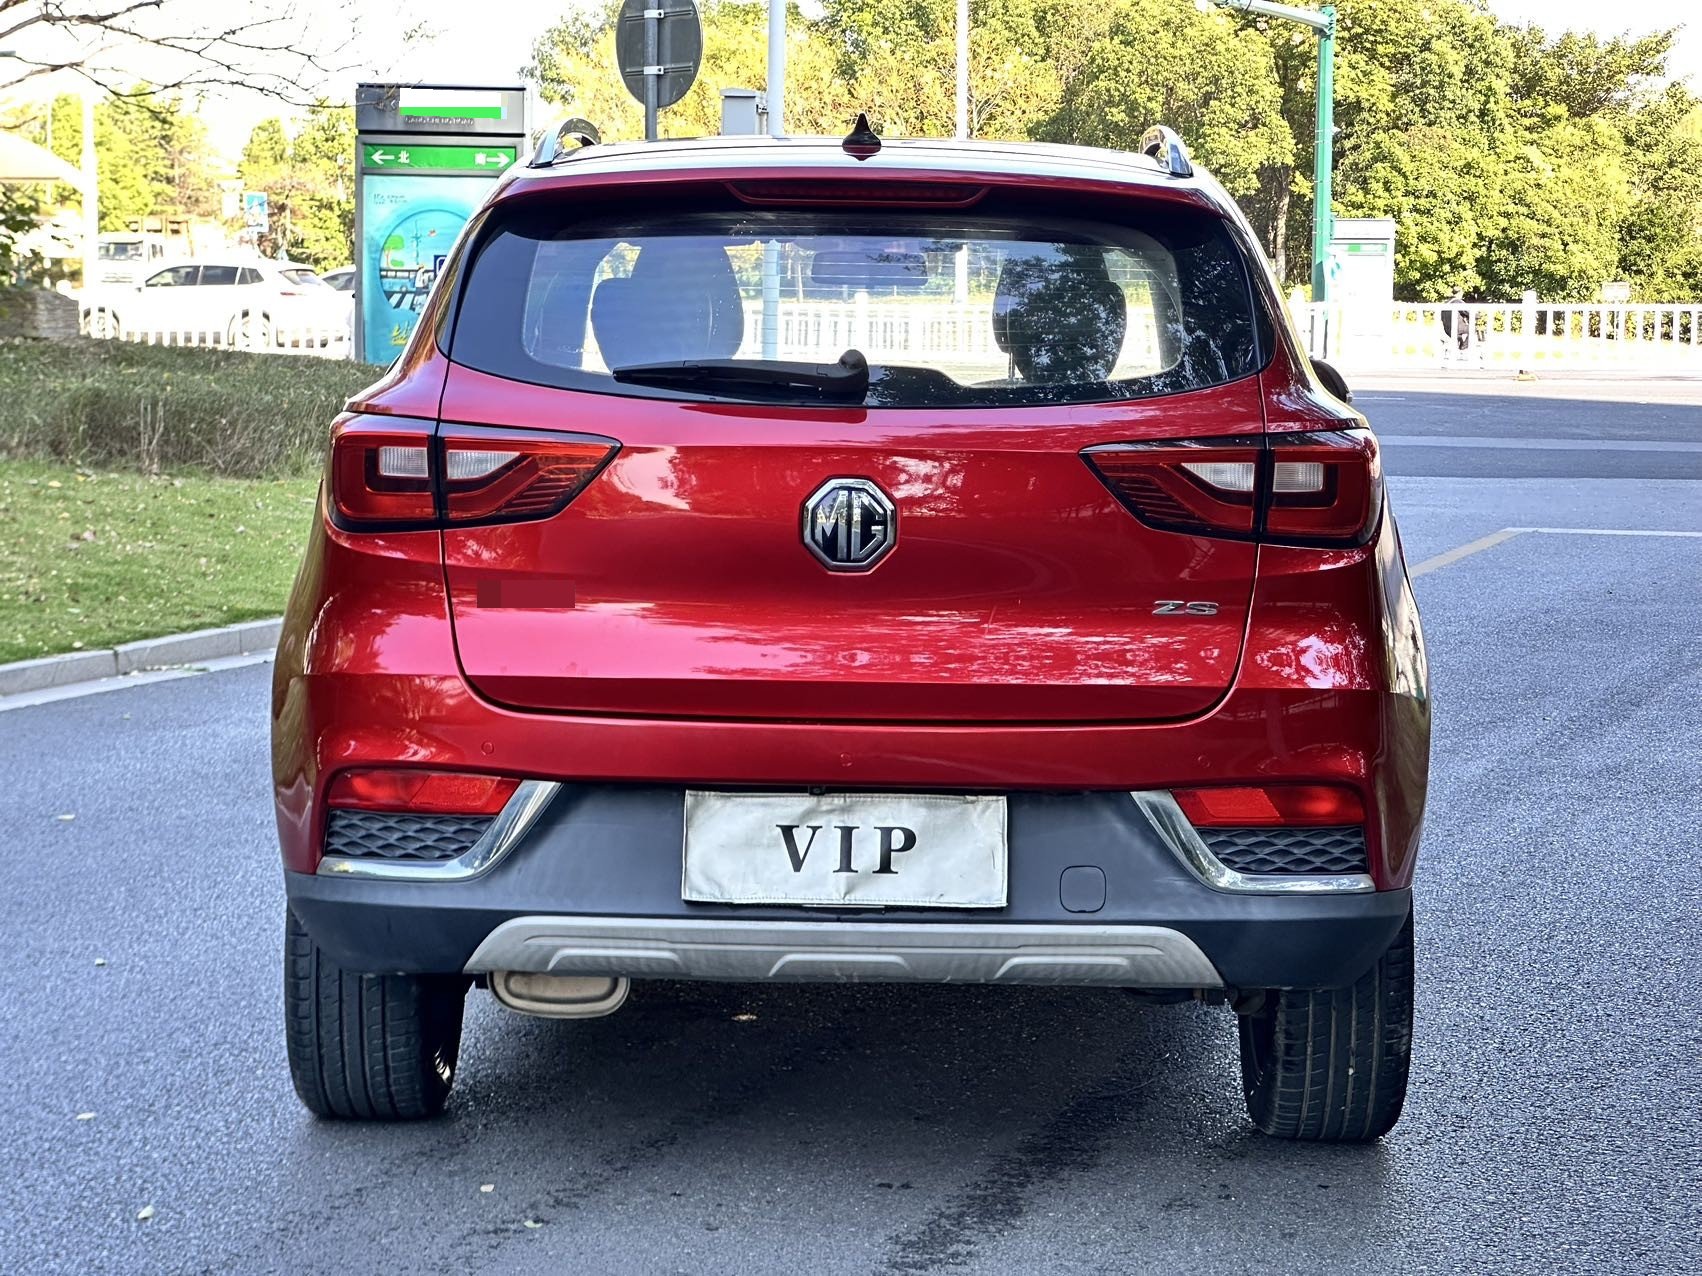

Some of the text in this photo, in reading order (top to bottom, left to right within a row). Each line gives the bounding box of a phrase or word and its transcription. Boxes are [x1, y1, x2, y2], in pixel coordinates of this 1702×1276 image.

[397, 150, 410, 164] 北
[815, 490, 884, 560] MG
[1152, 600, 1219, 615] ZS
[776, 824, 917, 874] VIP
